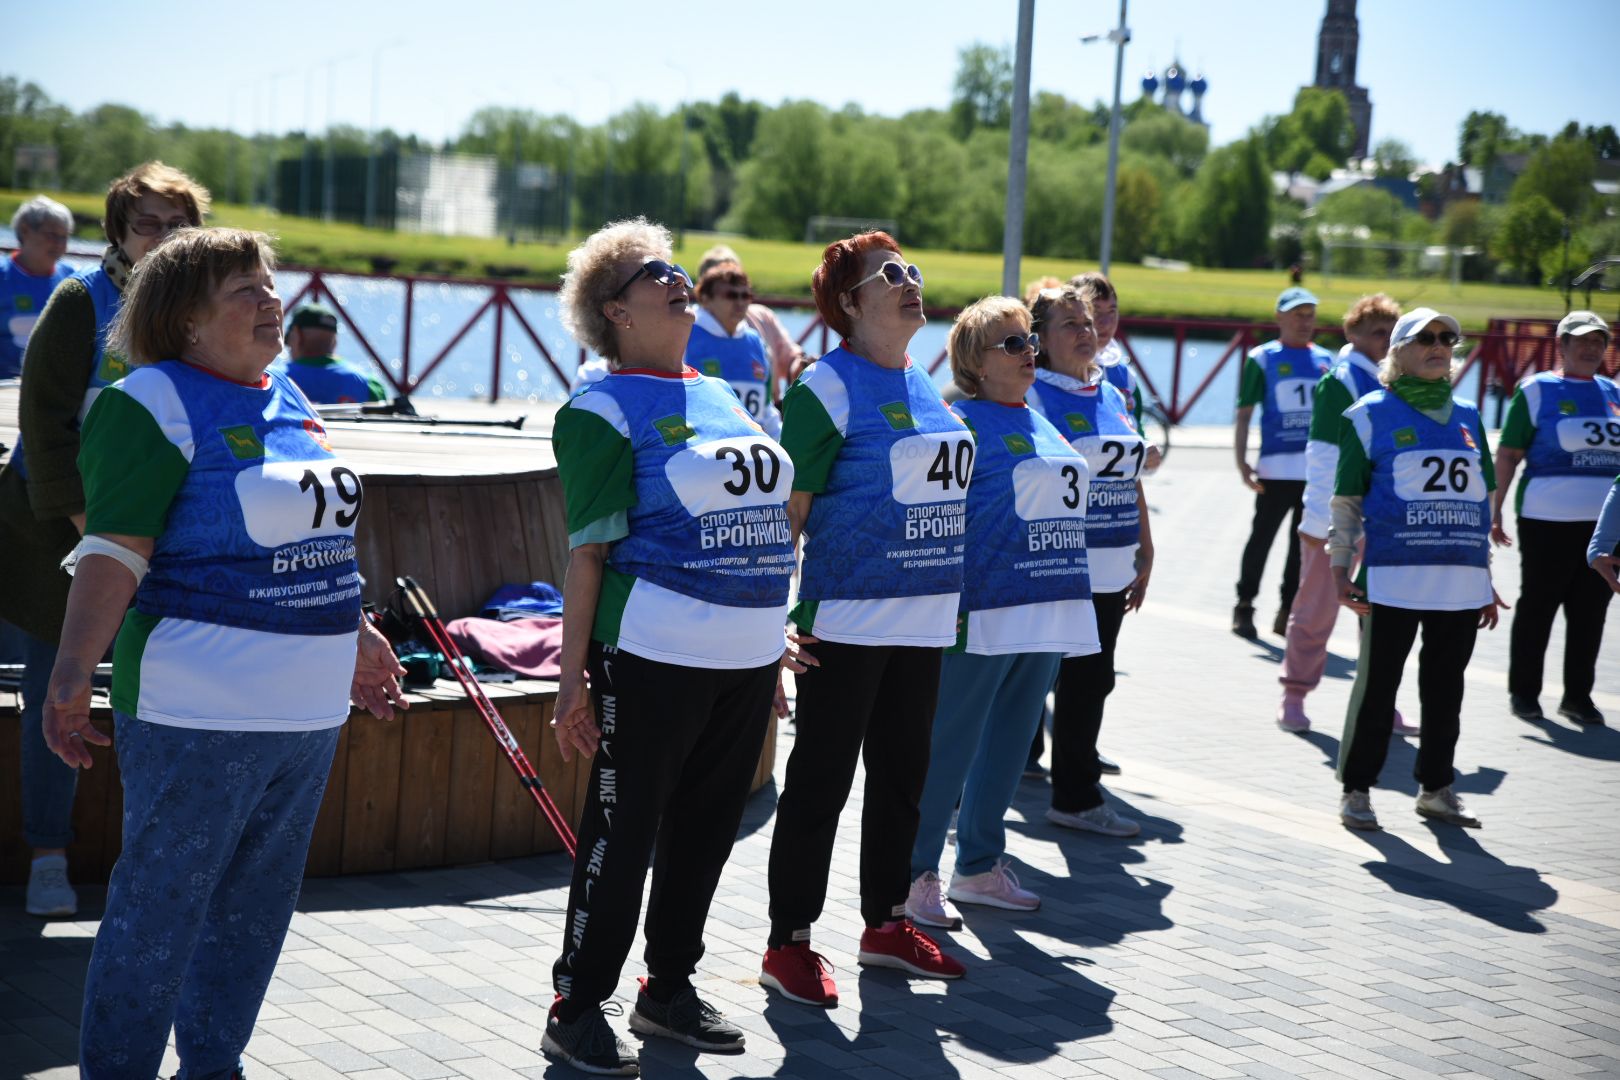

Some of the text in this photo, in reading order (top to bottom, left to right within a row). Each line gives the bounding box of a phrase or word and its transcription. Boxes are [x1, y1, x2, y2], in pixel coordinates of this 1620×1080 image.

[1583, 421, 1620, 447] 39
[715, 443, 781, 496] 30
[927, 439, 974, 491] 40
[1097, 440, 1145, 478] 21
[1421, 456, 1471, 493] 26
[298, 466, 364, 530] 19
[1061, 465, 1080, 510] 3
[700, 506, 773, 529] СПОРТИВНЫЙ
[1406, 501, 1463, 511] СПОРТИВНЫЙ
[1406, 510, 1481, 528] БРОННИЦЫ
[905, 514, 966, 540] БРОННИ
[1028, 530, 1086, 552] БРОННИ
[683, 556, 749, 569] #ЖИВУСПОРТОМ
[886, 546, 947, 559] #ЖИВУСПОРТОМ
[1013, 557, 1069, 570] #ЖИВУСПОРТОМ
[248, 580, 328, 599] #ЖИВУСПОРТОМ
[601, 694, 617, 734] NIKE
[600, 768, 617, 804] NIKE
[586, 837, 609, 876] NIKE
[572, 908, 590, 950] NIKE
